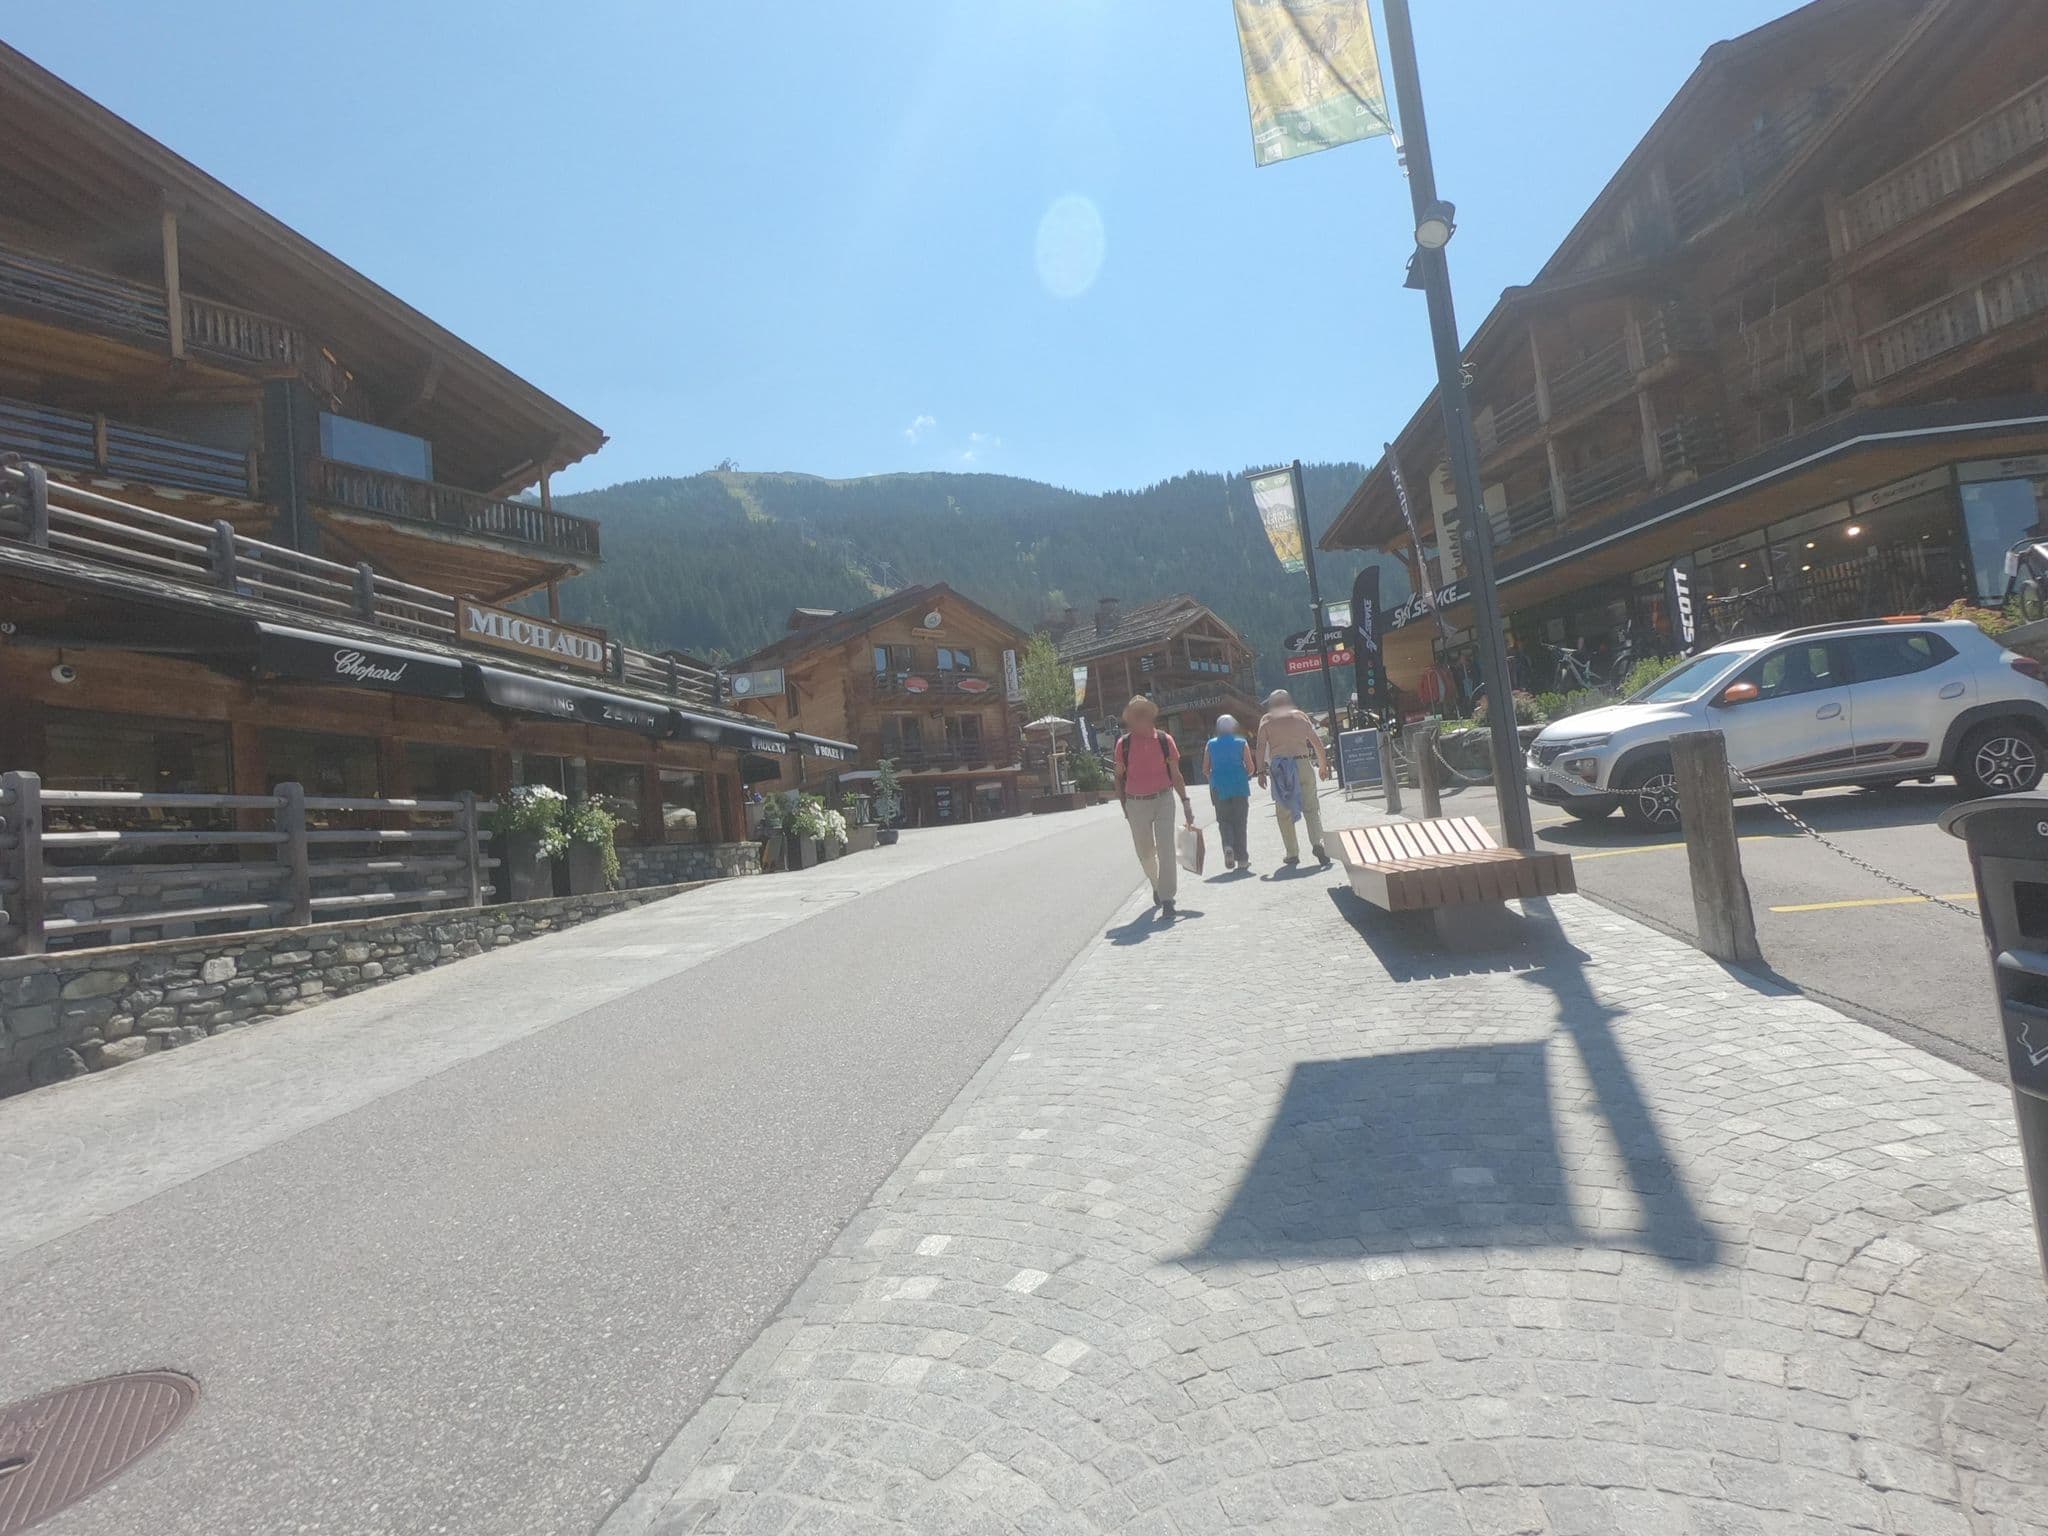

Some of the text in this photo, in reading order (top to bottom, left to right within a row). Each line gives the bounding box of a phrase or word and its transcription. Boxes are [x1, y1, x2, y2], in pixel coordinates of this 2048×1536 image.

[1673, 568, 1695, 642] SCOTT
[467, 607, 603, 662] MICHAUD
[334, 649, 408, 682] Chopard
